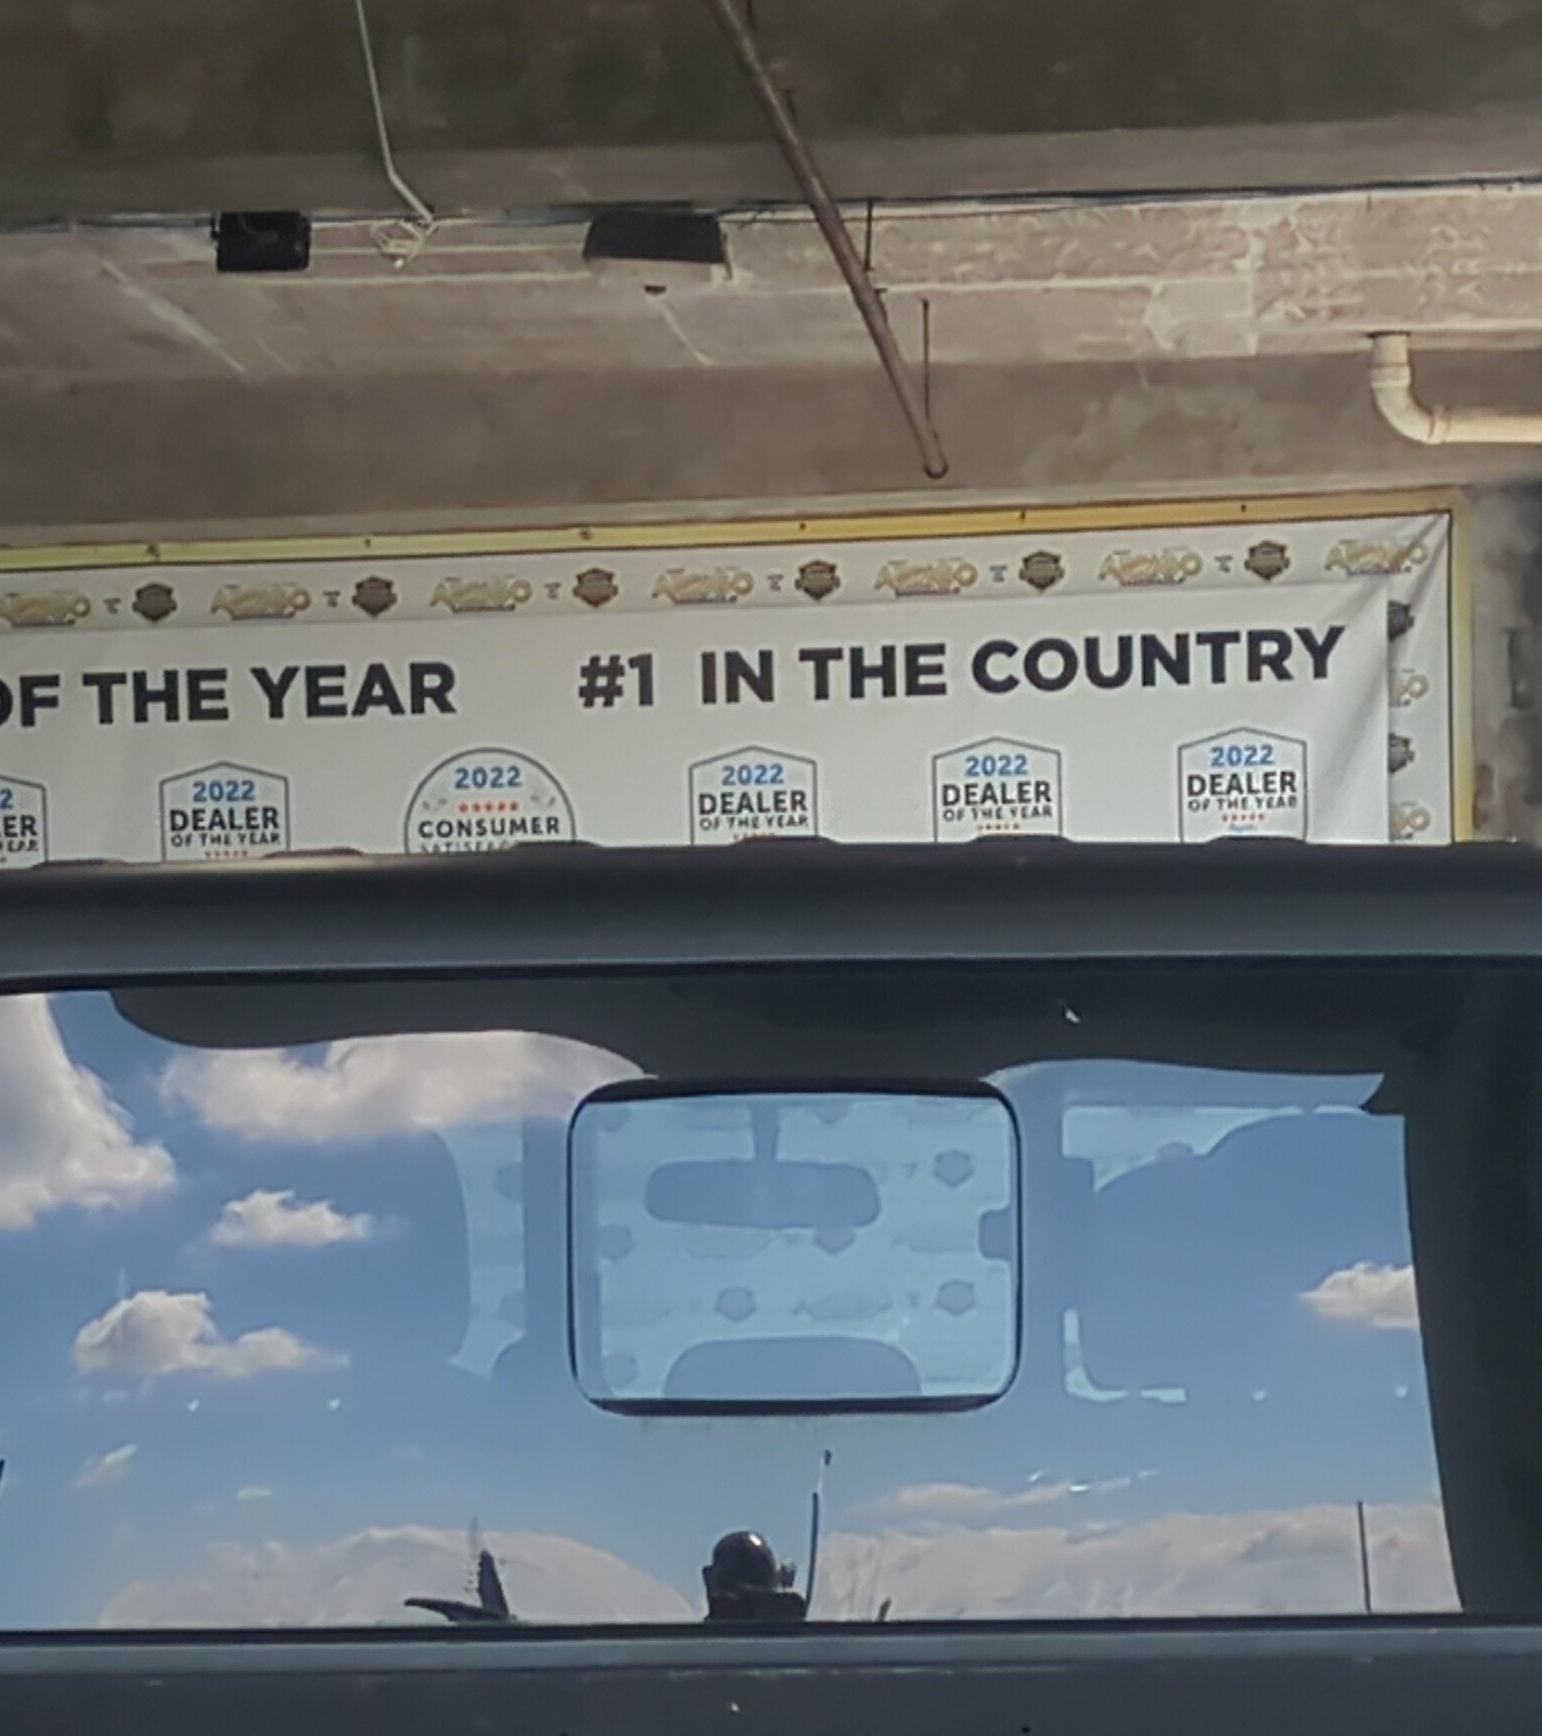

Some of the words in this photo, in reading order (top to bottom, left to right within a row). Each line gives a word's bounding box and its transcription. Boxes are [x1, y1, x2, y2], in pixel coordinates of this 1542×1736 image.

[578, 653, 654, 708] #1
[701, 649, 775, 704] IN
[799, 642, 948, 701] THE
[971, 625, 1347, 694] COUNTRY
[82, 667, 230, 724] THE
[250, 661, 457, 719] YEAR
[965, 754, 1028, 777] 2022
[1211, 744, 1274, 767] 2022
[455, 766, 522, 789] 2022
[722, 763, 784, 786] 2022
[1187, 771, 1297, 797] DEALER
[193, 780, 255, 802] 2022
[942, 780, 1052, 806] DEALER
[698, 790, 808, 816] DEALER
[943, 809, 965, 822] OF
[971, 807, 1004, 821] THE
[1010, 806, 1053, 819] YEAR
[1188, 799, 1210, 812] OF
[1216, 798, 1248, 811] THE
[1255, 796, 1297, 809] YEAR
[170, 806, 279, 832] DEALER
[418, 816, 560, 838] CONSUMER
[699, 817, 720, 831] OF
[728, 816, 760, 830] THE
[766, 815, 809, 828] YEAR
[171, 834, 192, 847] OF
[200, 833, 232, 846] THE
[238, 832, 281, 845] YEAR
